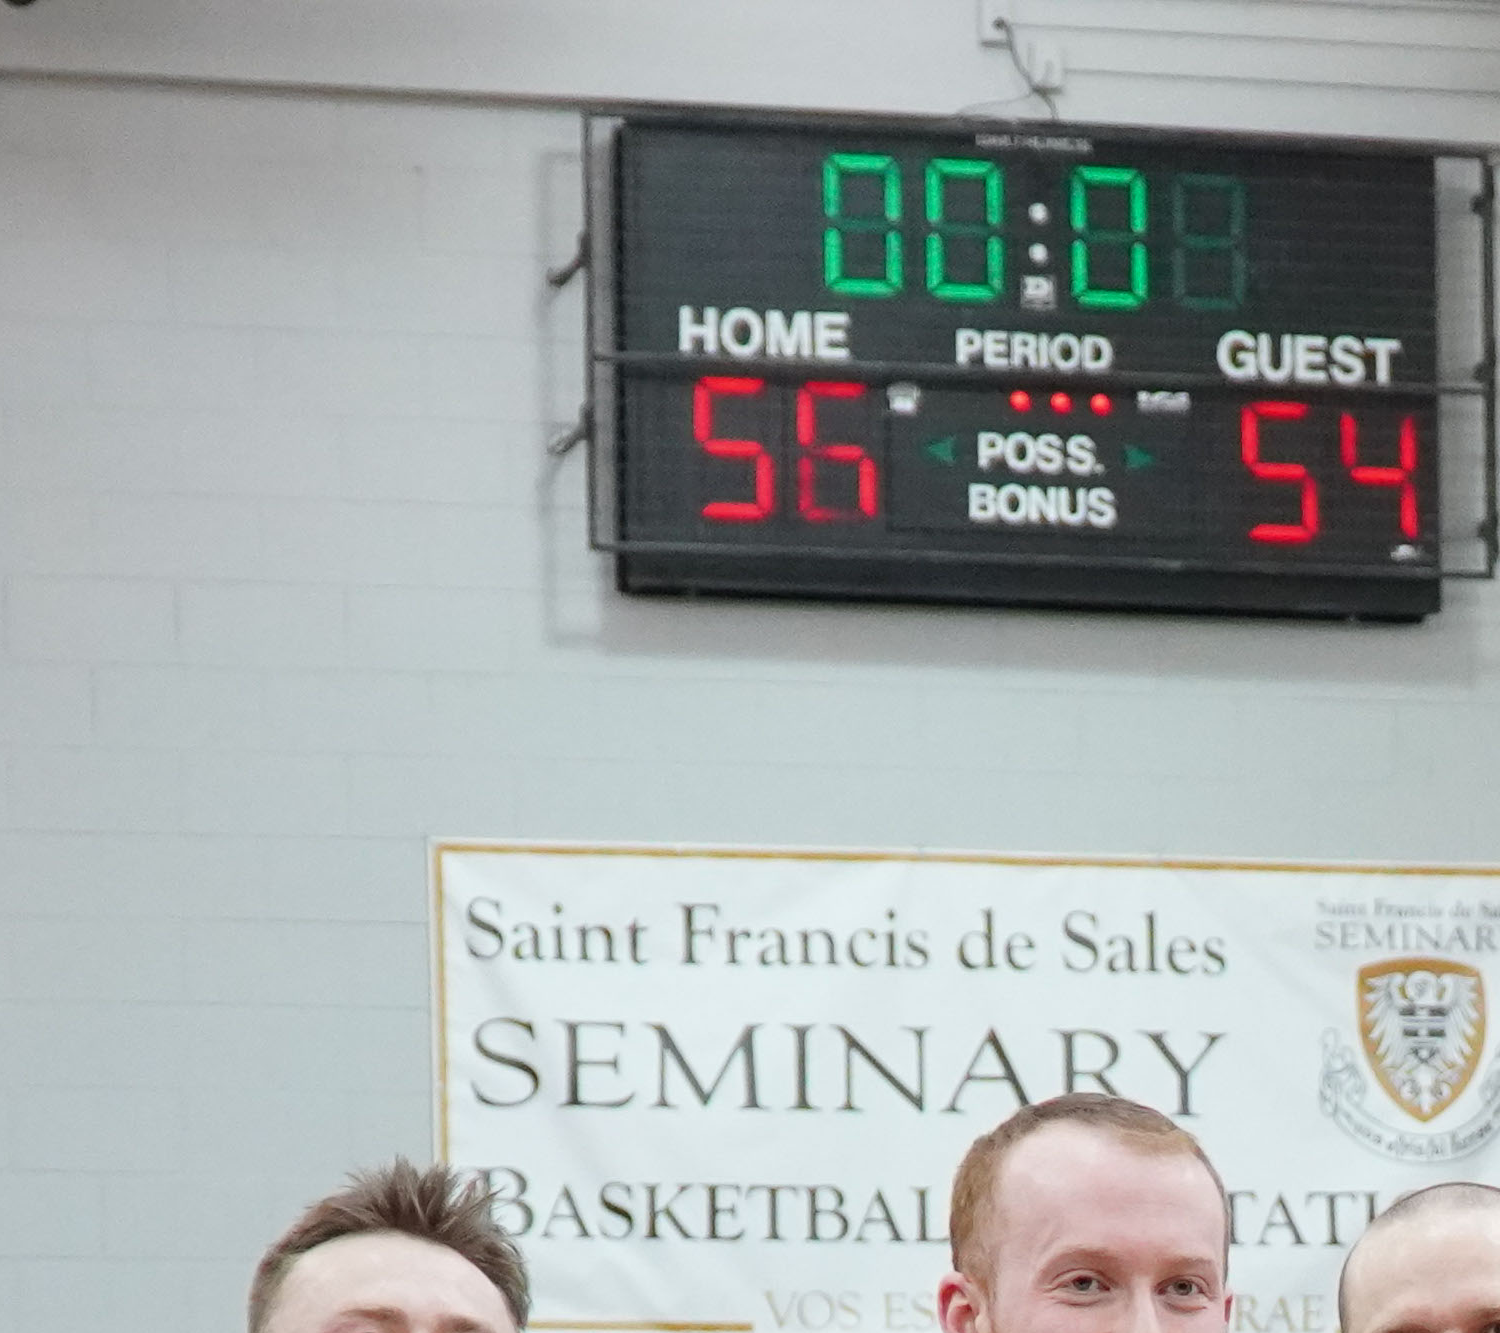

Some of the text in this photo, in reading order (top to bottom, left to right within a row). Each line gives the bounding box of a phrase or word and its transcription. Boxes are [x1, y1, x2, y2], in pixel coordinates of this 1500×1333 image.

[677, 305, 850, 361] HOME
[955, 327, 1113, 371] PERIOD
[1216, 330, 1401, 386] GUEST
[694, 377, 877, 522] 56
[977, 431, 1106, 477] POSS.
[1241, 402, 1418, 543] 54
[968, 482, 1117, 529] BONUS
[465, 896, 1228, 976] Saint Francis de Sales
[471, 1015, 1227, 1118] SEMINARY
[764, 1290, 861, 1331] VOS
